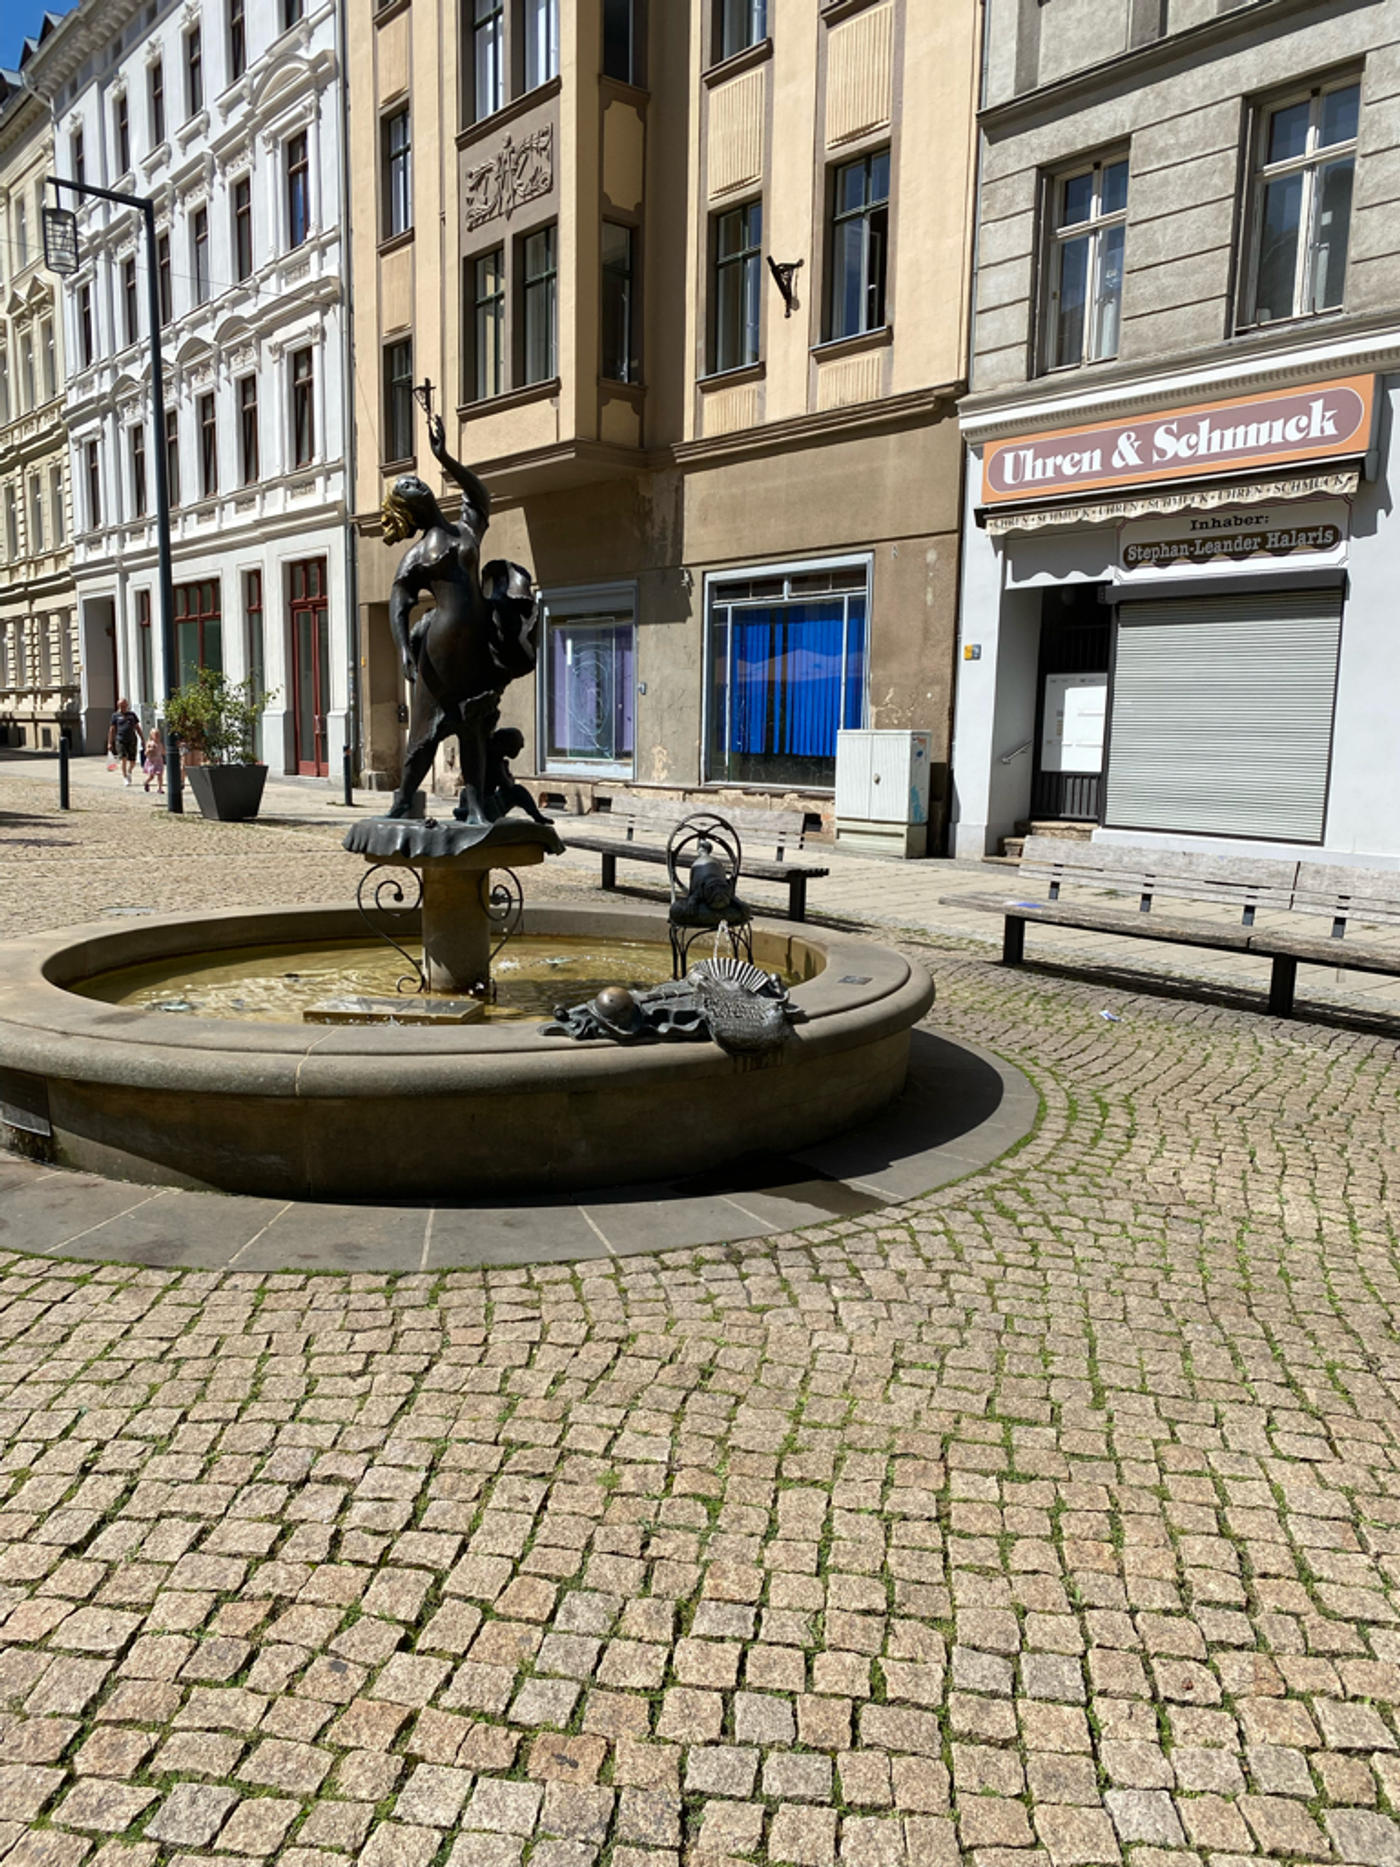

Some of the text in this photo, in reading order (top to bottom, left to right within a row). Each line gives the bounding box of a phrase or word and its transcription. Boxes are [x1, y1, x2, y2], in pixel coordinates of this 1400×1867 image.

[1002, 398, 1340, 485] Uhren & Schmuck
[1273, 475, 1343, 493] SCHMUCK
[1190, 514, 1270, 532] Inhaber:
[1127, 527, 1334, 565] Stephan-Leander Halaris
